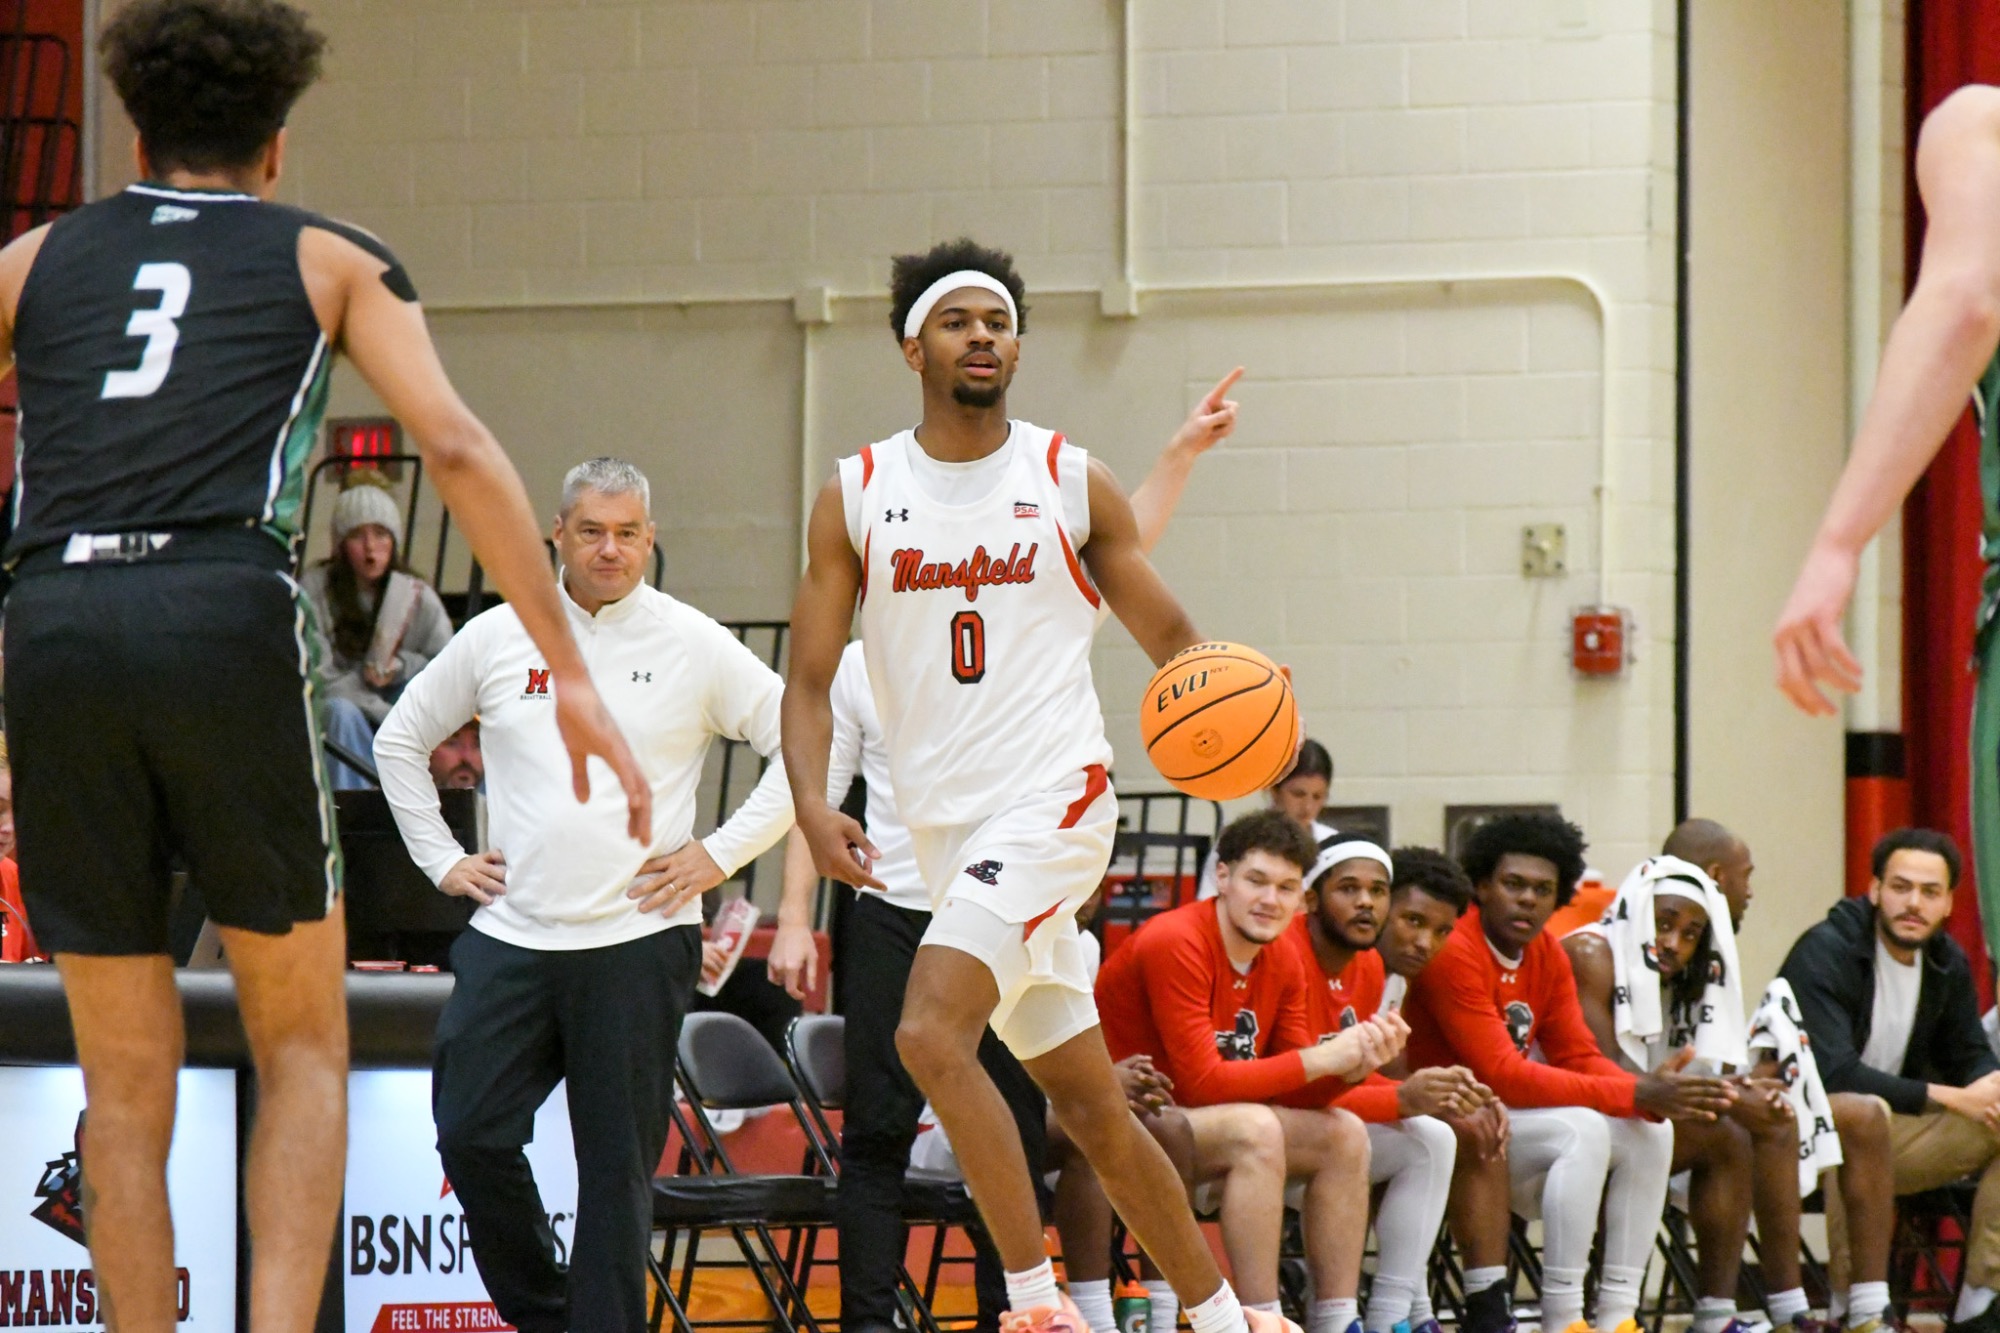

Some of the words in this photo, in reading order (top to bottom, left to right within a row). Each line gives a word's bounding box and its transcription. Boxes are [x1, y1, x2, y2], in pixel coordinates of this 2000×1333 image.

[101, 263, 191, 399] 3
[1014, 506, 1039, 515] PSAC
[891, 543, 1039, 602] Mansfield
[950, 610, 986, 684] 0
[525, 668, 551, 694] M
[0, 1267, 190, 1326] MANSD
[391, 1309, 421, 1330] FEEL
[424, 1308, 451, 1329] THE
